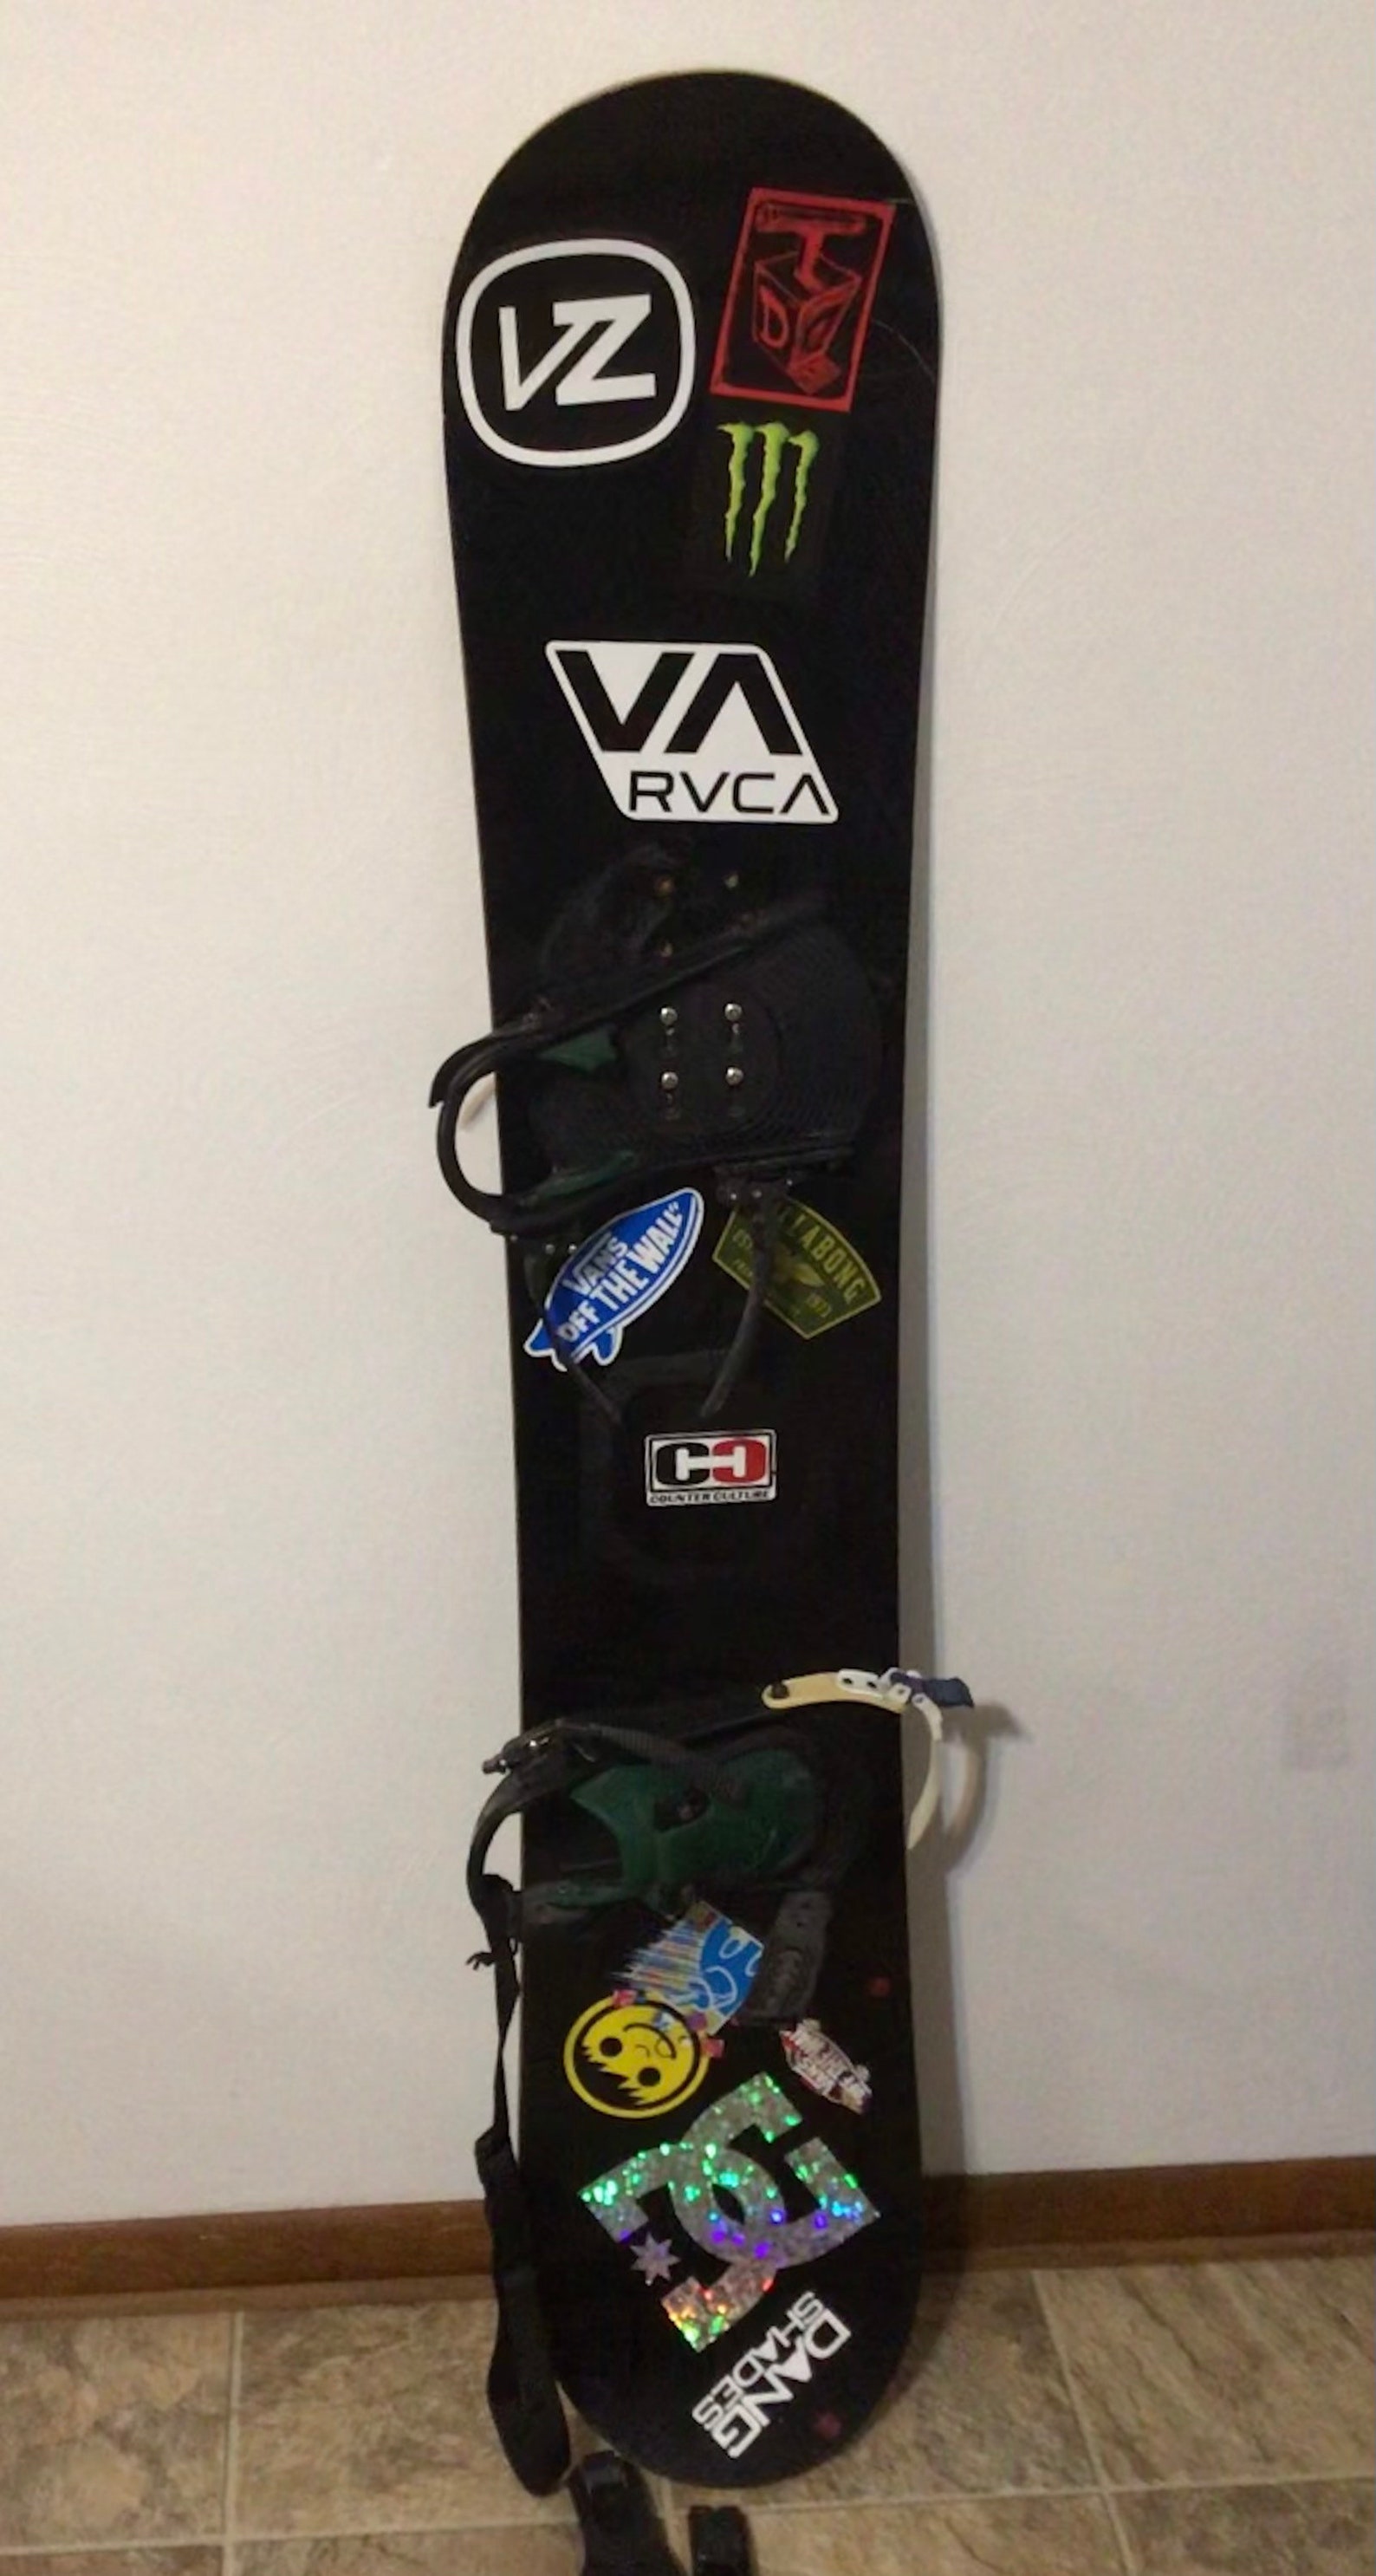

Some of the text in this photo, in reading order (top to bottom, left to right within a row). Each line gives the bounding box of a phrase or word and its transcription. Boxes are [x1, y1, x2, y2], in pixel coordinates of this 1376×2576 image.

[499, 294, 656, 411] VZ
[555, 650, 802, 755] VA
[629, 771, 829, 815] RVCA
[561, 1232, 629, 1295] VANS
[589, 1259, 650, 1311] THE
[650, 1490, 768, 1504] COUNTER CULTURE
[577, 2072, 879, 2352] DC
[692, 2292, 824, 2426] SHADES
[711, 2306, 852, 2459] DANG
